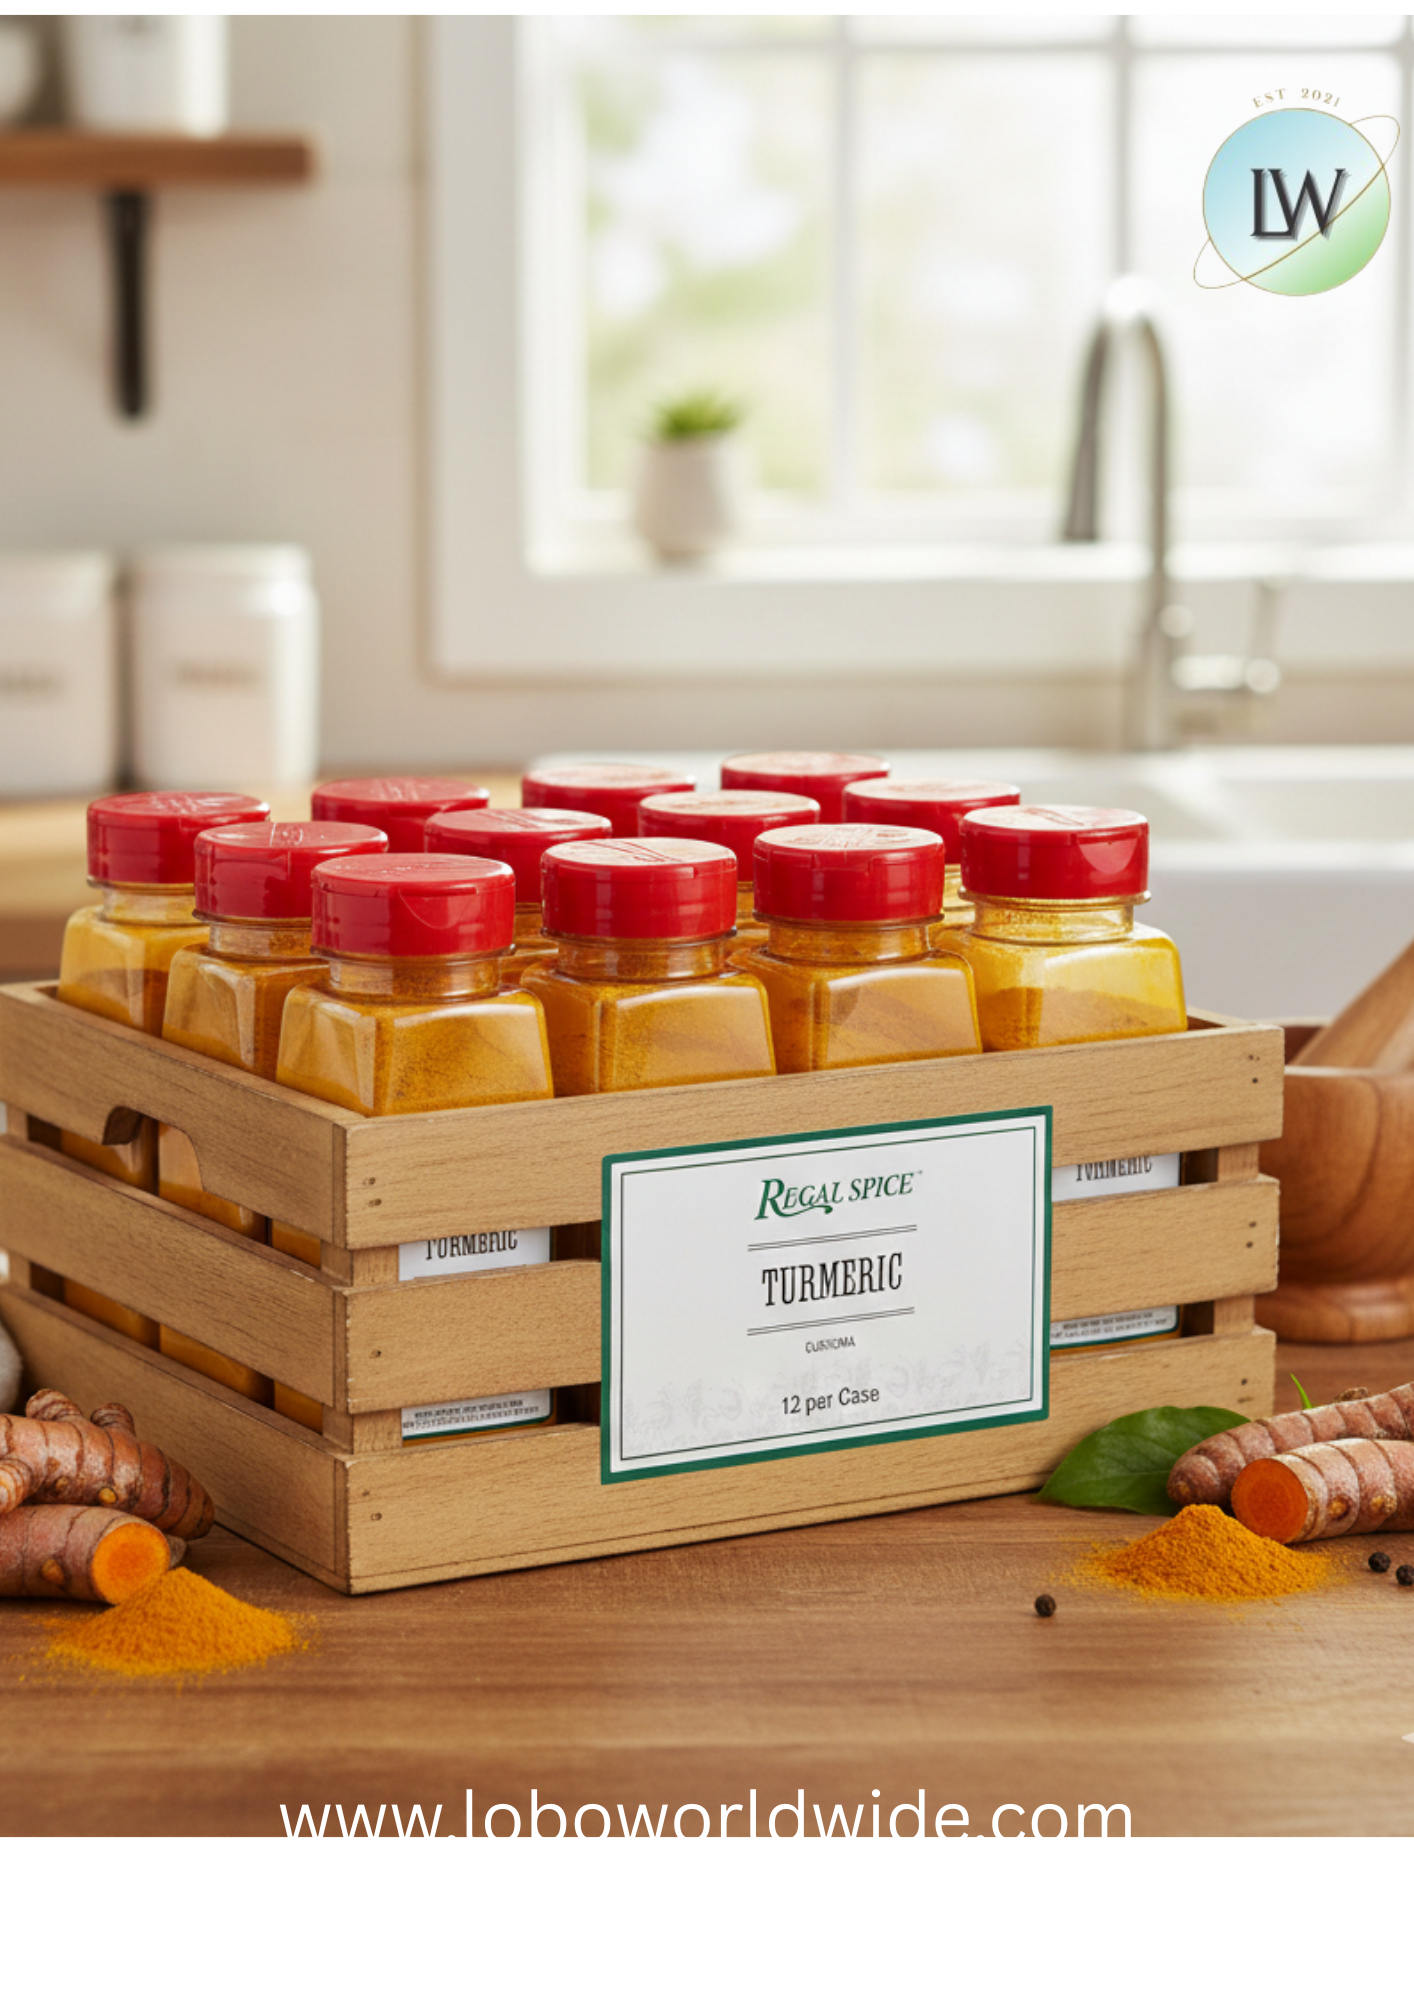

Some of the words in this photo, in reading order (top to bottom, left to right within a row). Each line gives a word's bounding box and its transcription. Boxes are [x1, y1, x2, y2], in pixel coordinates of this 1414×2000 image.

[754, 1178, 844, 1220] REGAL
[848, 1172, 914, 1202] SPICE
[761, 1252, 903, 1306] TURMERIC
[782, 1395, 801, 1414] 12
[805, 1394, 833, 1416] per
[838, 1387, 880, 1406] Case
